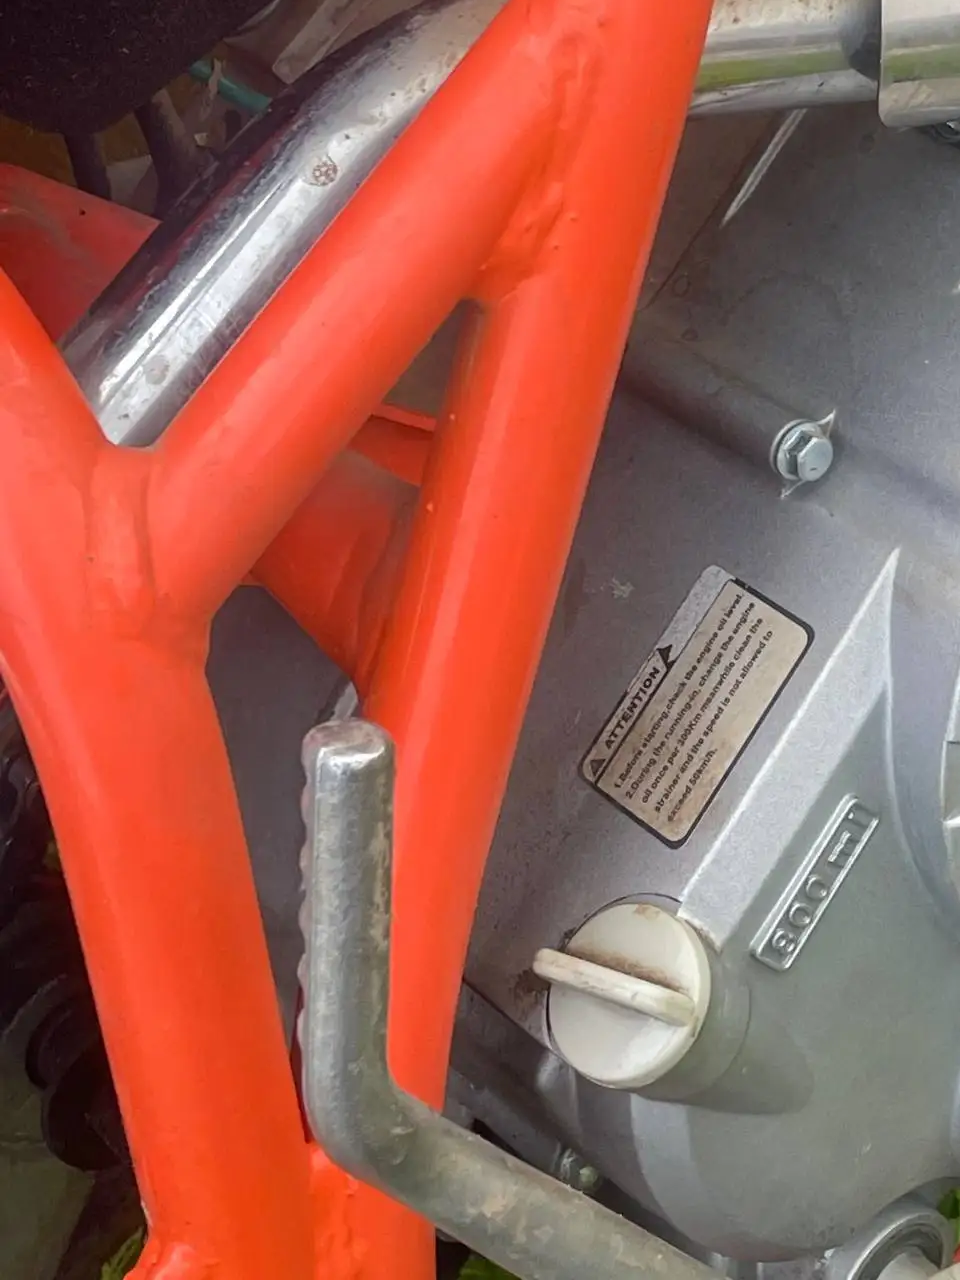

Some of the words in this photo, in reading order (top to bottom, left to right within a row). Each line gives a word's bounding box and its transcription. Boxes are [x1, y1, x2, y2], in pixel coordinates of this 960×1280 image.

[601, 665, 662, 750] ATTENTION
[651, 738, 667, 757] the
[695, 650, 725, 688] change
[719, 633, 735, 652] the
[730, 600, 757, 636] engine
[682, 662, 698, 681] the
[694, 630, 721, 666] engine
[714, 616, 728, 632] oil
[638, 787, 653, 804] oil
[649, 763, 670, 790] once
[665, 745, 682, 766] per
[697, 659, 736, 713] meanwhile
[731, 632, 753, 661] clean
[748, 615, 764, 635] the
[650, 770, 683, 813] strainer
[675, 751, 695, 774] and
[688, 735, 705, 755] the
[699, 704, 726, 739] speed
[719, 694, 731, 707] is
[726, 677, 743, 697] not
[737, 640, 766, 679] allowed
[761, 628, 774, 642] to
[664, 784, 693, 823] exceed
